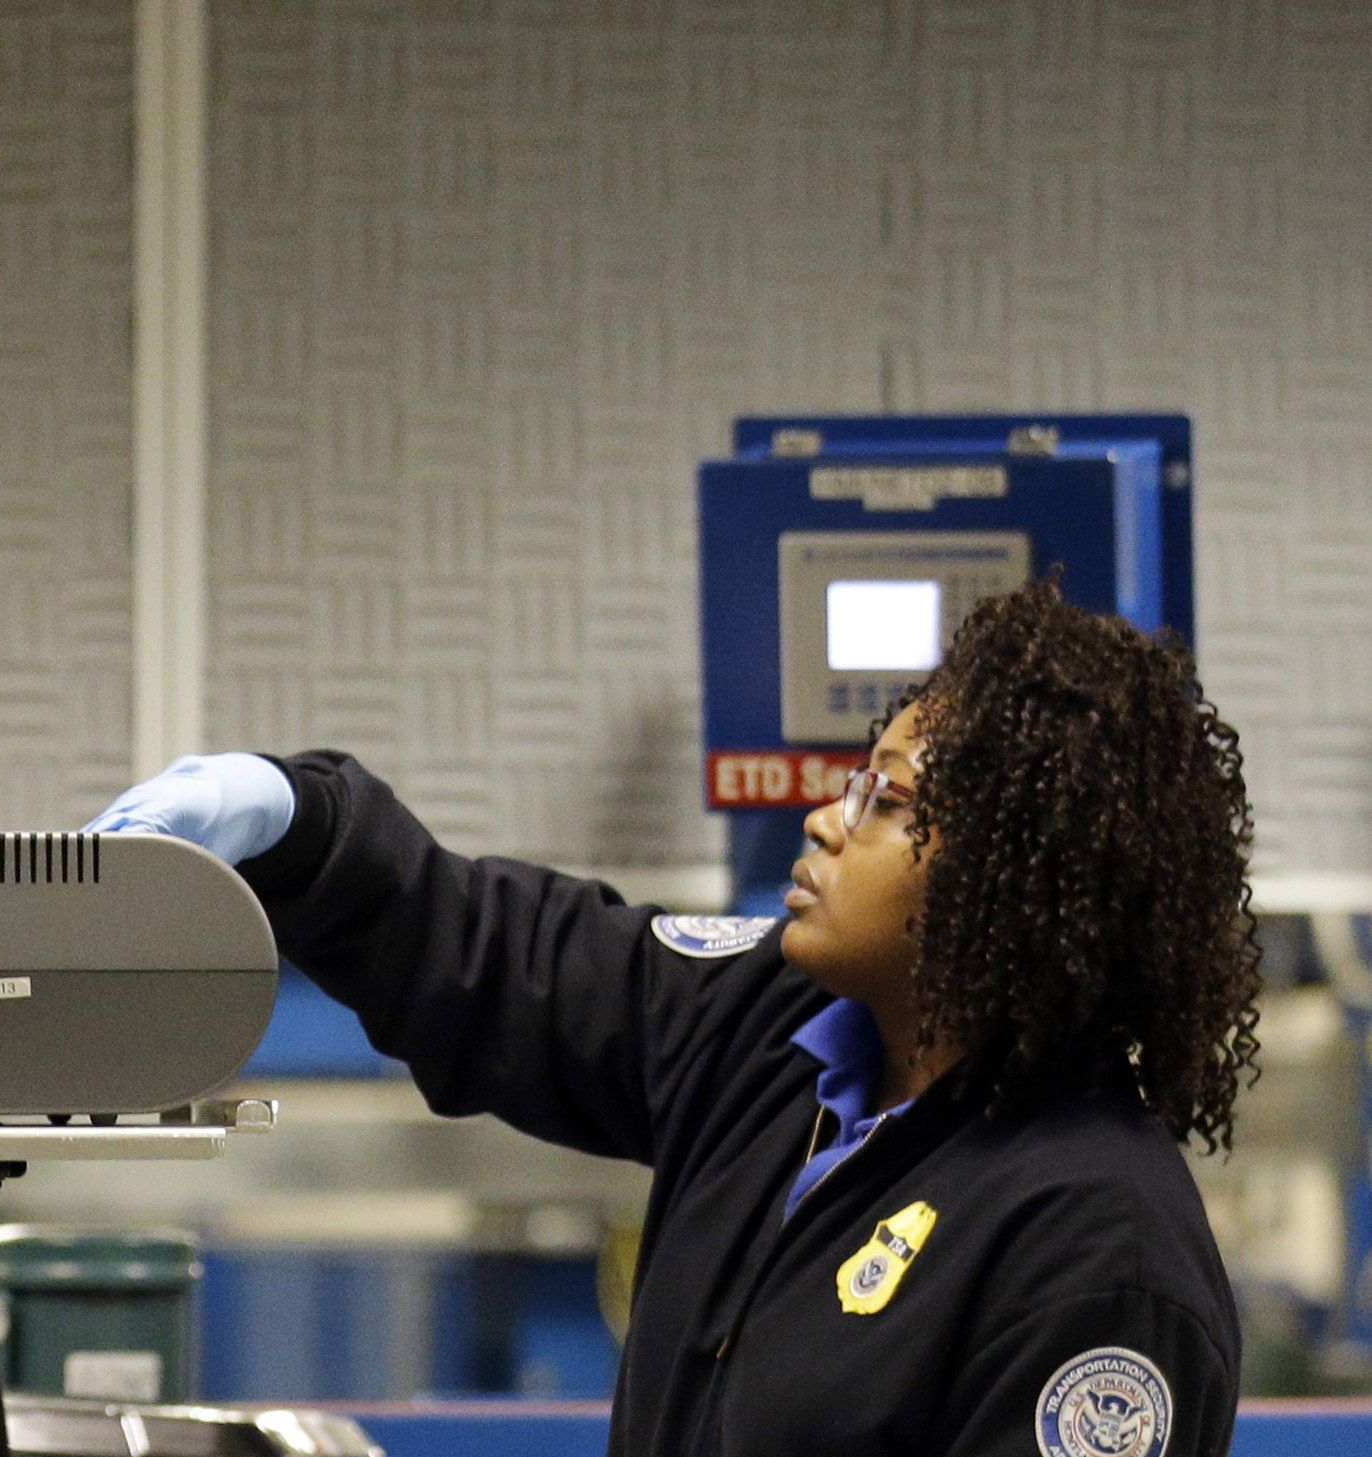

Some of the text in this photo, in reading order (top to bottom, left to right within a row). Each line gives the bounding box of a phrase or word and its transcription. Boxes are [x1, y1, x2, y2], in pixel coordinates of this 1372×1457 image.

[716, 756, 790, 801] ETD
[1045, 1358, 1166, 1443] TRANSPORTATION SECURITY
